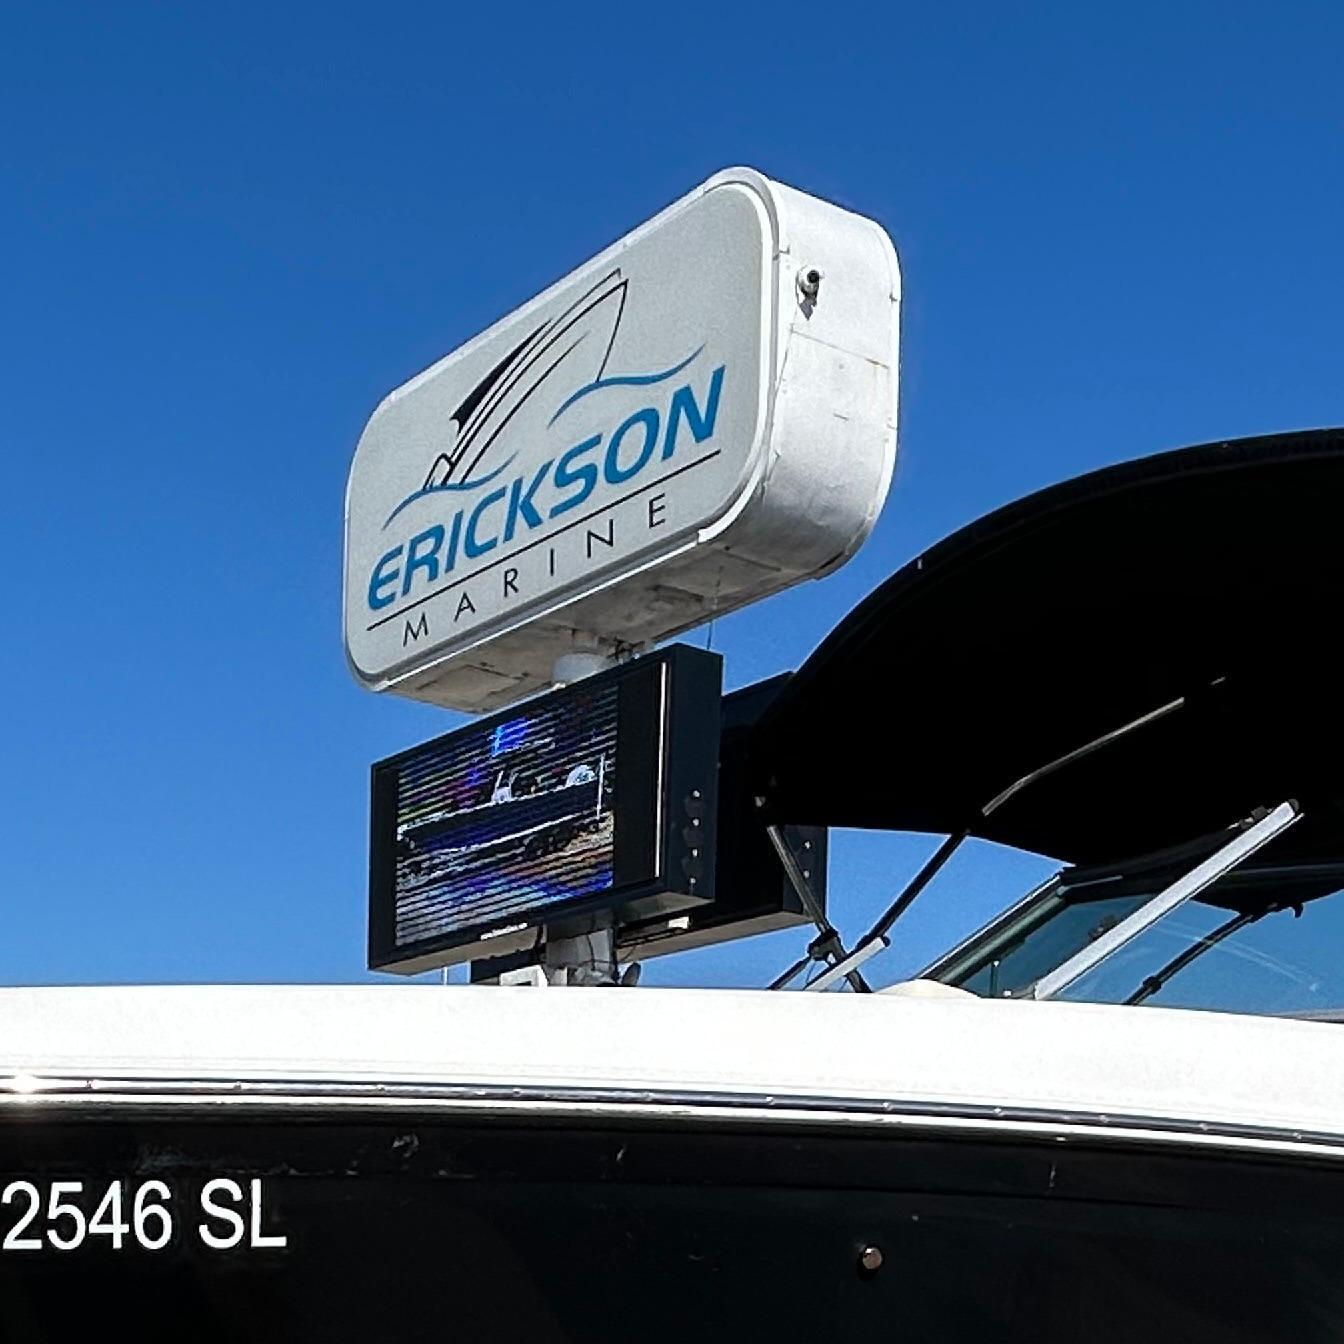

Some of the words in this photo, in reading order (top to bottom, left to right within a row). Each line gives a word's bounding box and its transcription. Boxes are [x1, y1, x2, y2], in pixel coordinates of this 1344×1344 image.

[367, 365, 726, 611] ERICKSON
[402, 493, 667, 648] MARINE
[1, 1180, 172, 1250] 2546
[199, 1178, 287, 1248] SL
